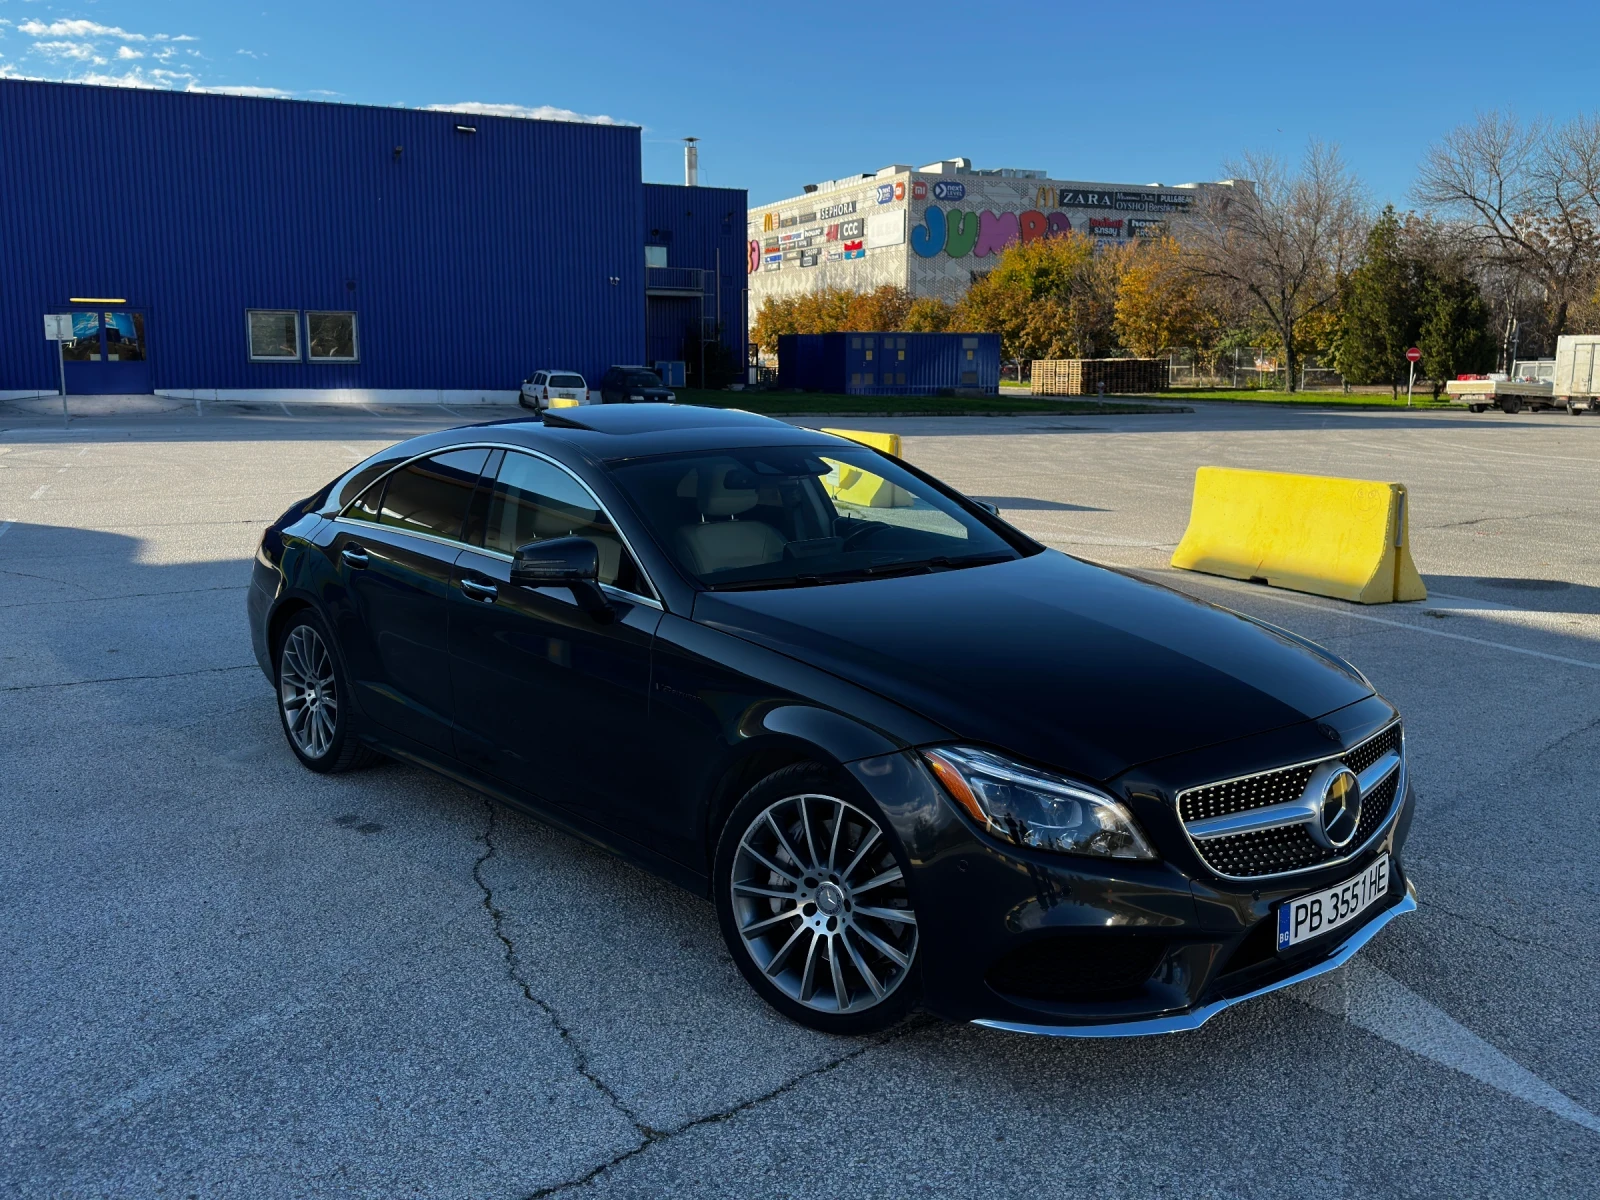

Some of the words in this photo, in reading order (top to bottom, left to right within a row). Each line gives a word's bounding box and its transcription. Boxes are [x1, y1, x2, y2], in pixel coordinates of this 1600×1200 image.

[946, 184, 962, 192] next
[1063, 192, 1112, 206] ZARA
[821, 201, 854, 220] SEPHORA
[1116, 202, 1144, 211] OYSHO
[843, 222, 858, 236] CCC
[1294, 898, 1322, 938] PB
[1280, 931, 1290, 944] BG
